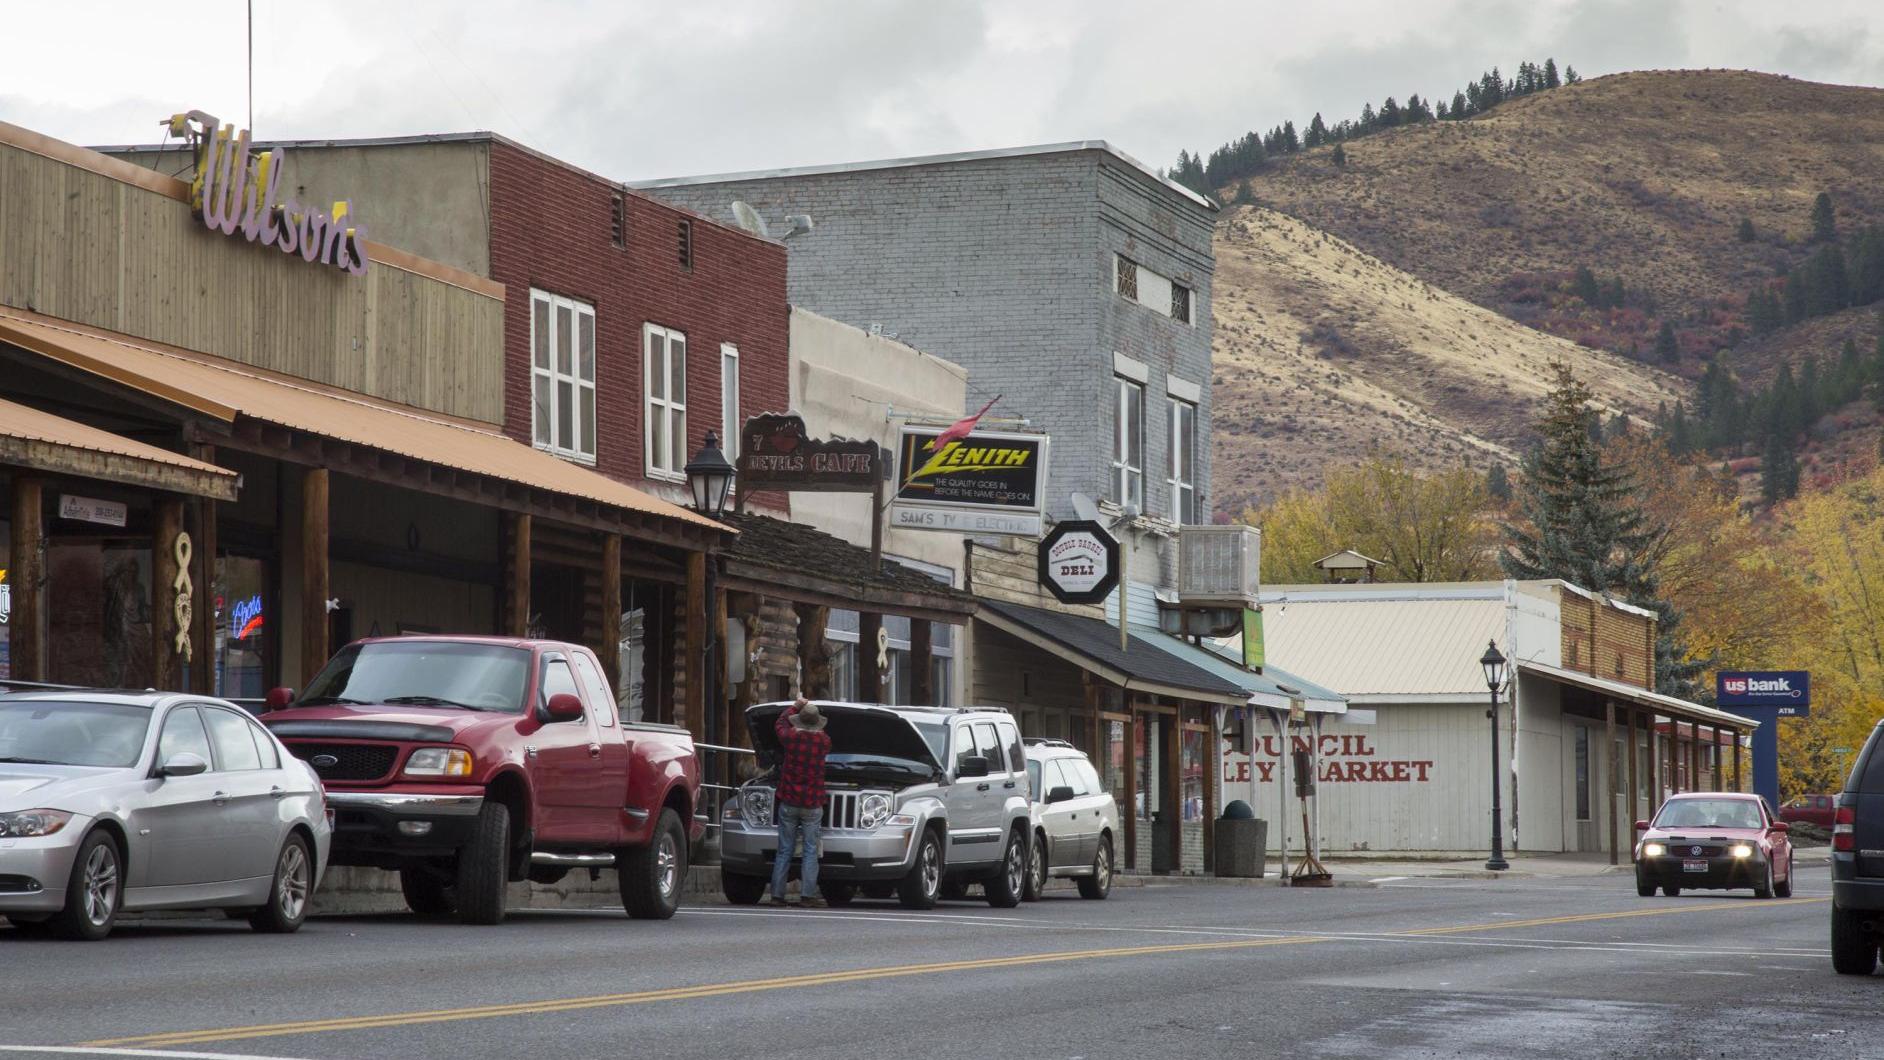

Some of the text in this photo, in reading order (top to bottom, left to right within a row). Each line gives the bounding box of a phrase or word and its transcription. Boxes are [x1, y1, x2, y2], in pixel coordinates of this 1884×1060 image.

[752, 434, 763, 451] 7
[748, 453, 871, 473] DEVILS CAFE
[917, 439, 1031, 477] ZENITH
[936, 478, 1008, 489] THE QUALITY GOES IN
[934, 487, 960, 496] BEFORE
[961, 489, 973, 497] THE
[974, 490, 995, 498] NAME
[901, 511, 934, 525] SAM'S
[943, 514, 956, 526] TV
[1061, 565, 1094, 576] DELI
[1725, 678, 1791, 691] us bank
